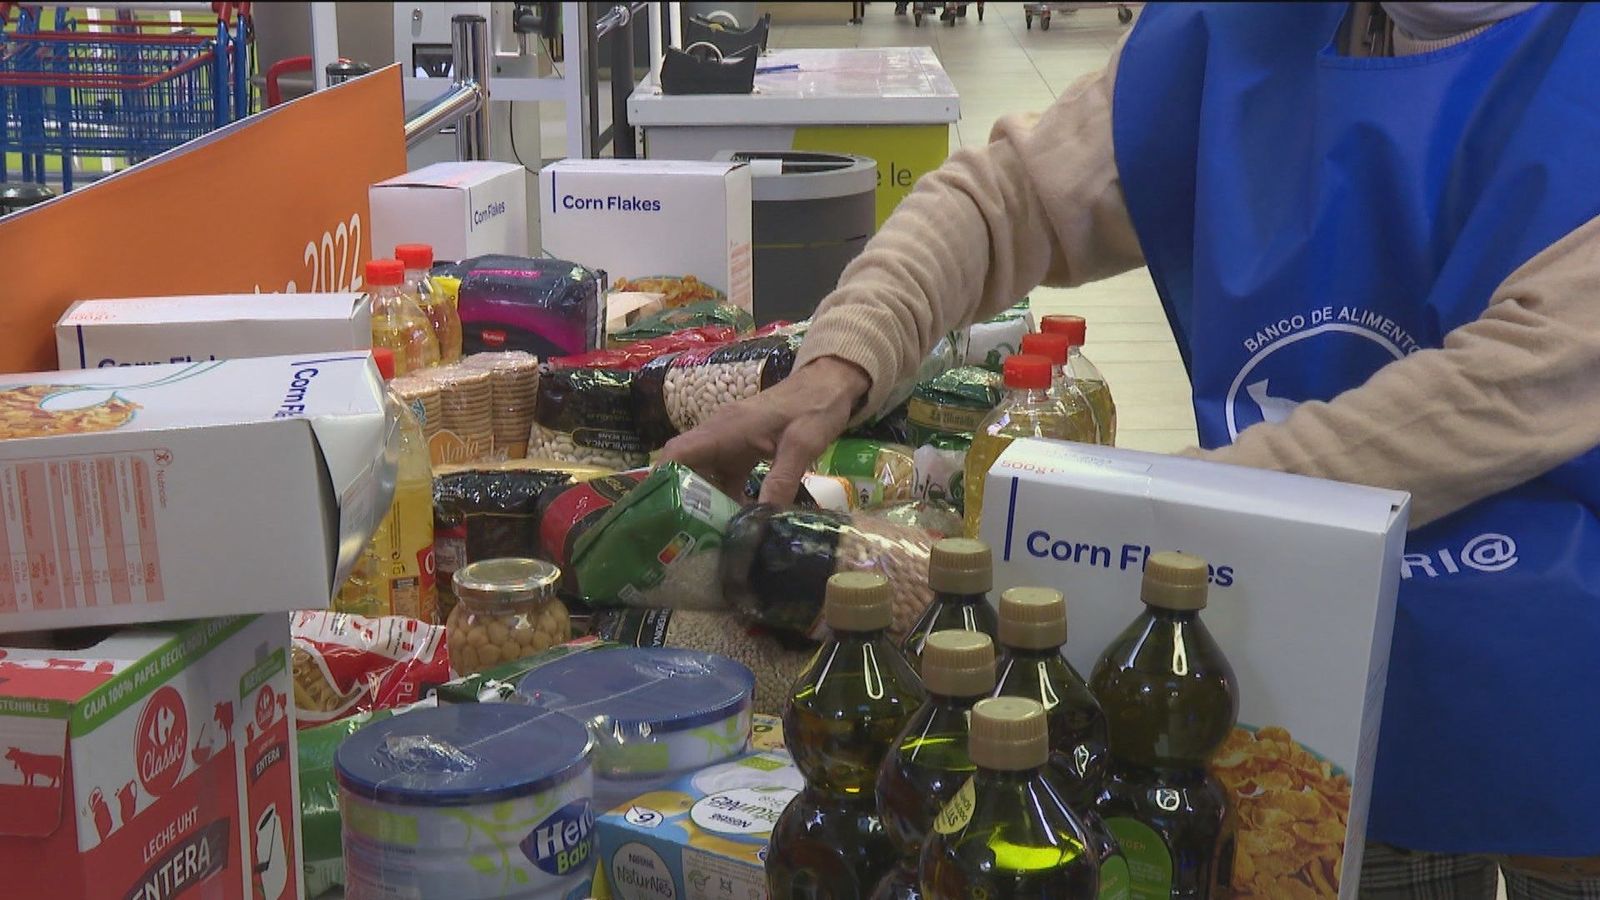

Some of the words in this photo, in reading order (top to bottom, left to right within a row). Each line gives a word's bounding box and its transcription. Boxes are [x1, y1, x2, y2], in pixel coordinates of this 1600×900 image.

[891, 161, 912, 187] le
[474, 206, 488, 225] Corn
[488, 200, 505, 218] Flakes
[562, 194, 604, 211] Corn
[607, 195, 662, 212] Flakes
[304, 213, 363, 294] 2022
[1244, 314, 1306, 353] BANCO
[1311, 306, 1334, 325] DE
[284, 368, 319, 403] Corn
[1026, 530, 1111, 568] Corn
[1120, 544, 1235, 588] Fls
[83, 696, 108, 720] CAJA
[108, 680, 134, 705] 100%
[134, 663, 160, 688] PAPEL
[142, 731, 186, 783] Classic
[255, 746, 281, 776] ENTERA
[143, 821, 177, 864] LECHE
[177, 806, 199, 835] UHT
[536, 801, 594, 861] Hero
[557, 839, 592, 875] Baby
